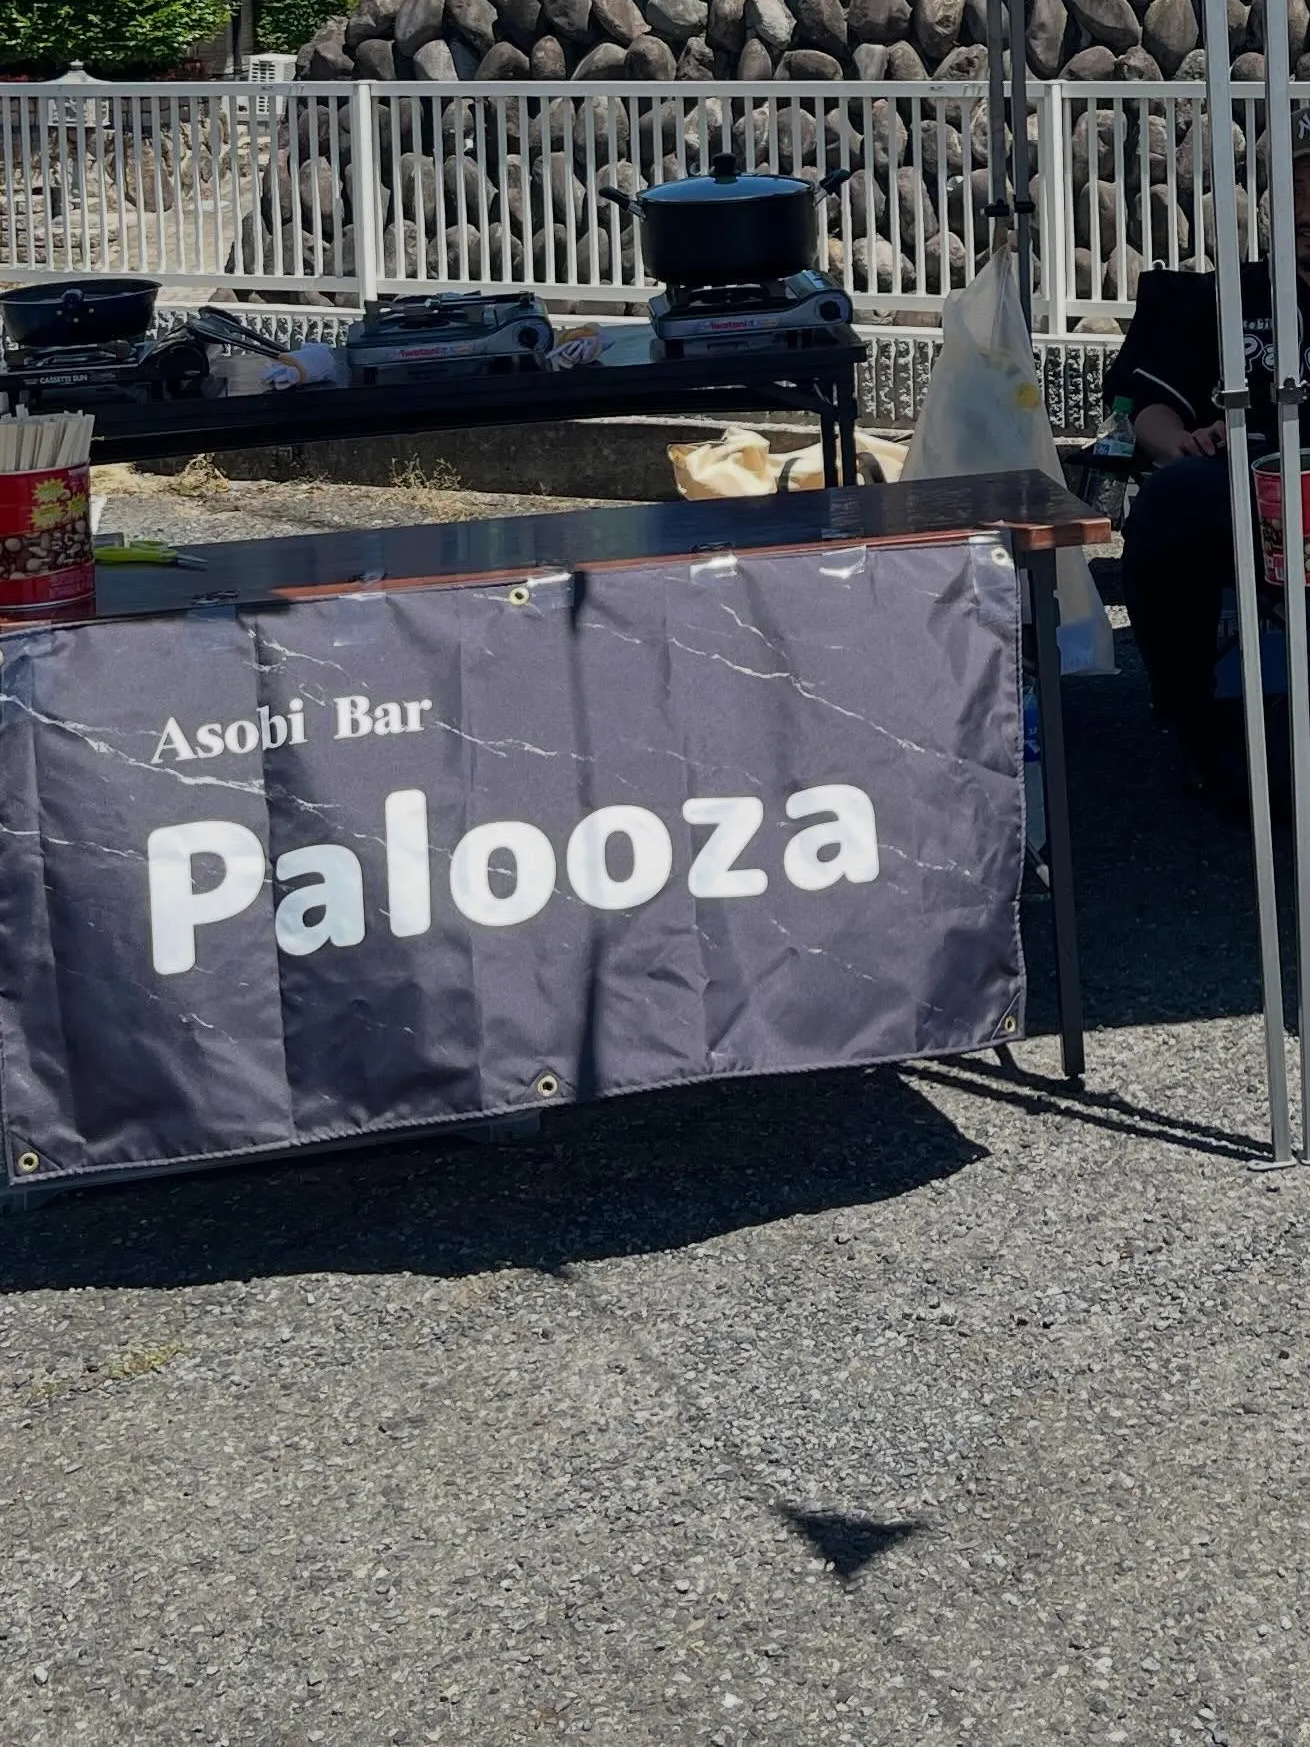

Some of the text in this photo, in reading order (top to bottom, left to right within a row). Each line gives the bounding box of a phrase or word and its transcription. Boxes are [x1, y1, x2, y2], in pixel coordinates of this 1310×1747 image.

[150, 695, 433, 764] Asobi Bar
[146, 782, 881, 976] Palooza
